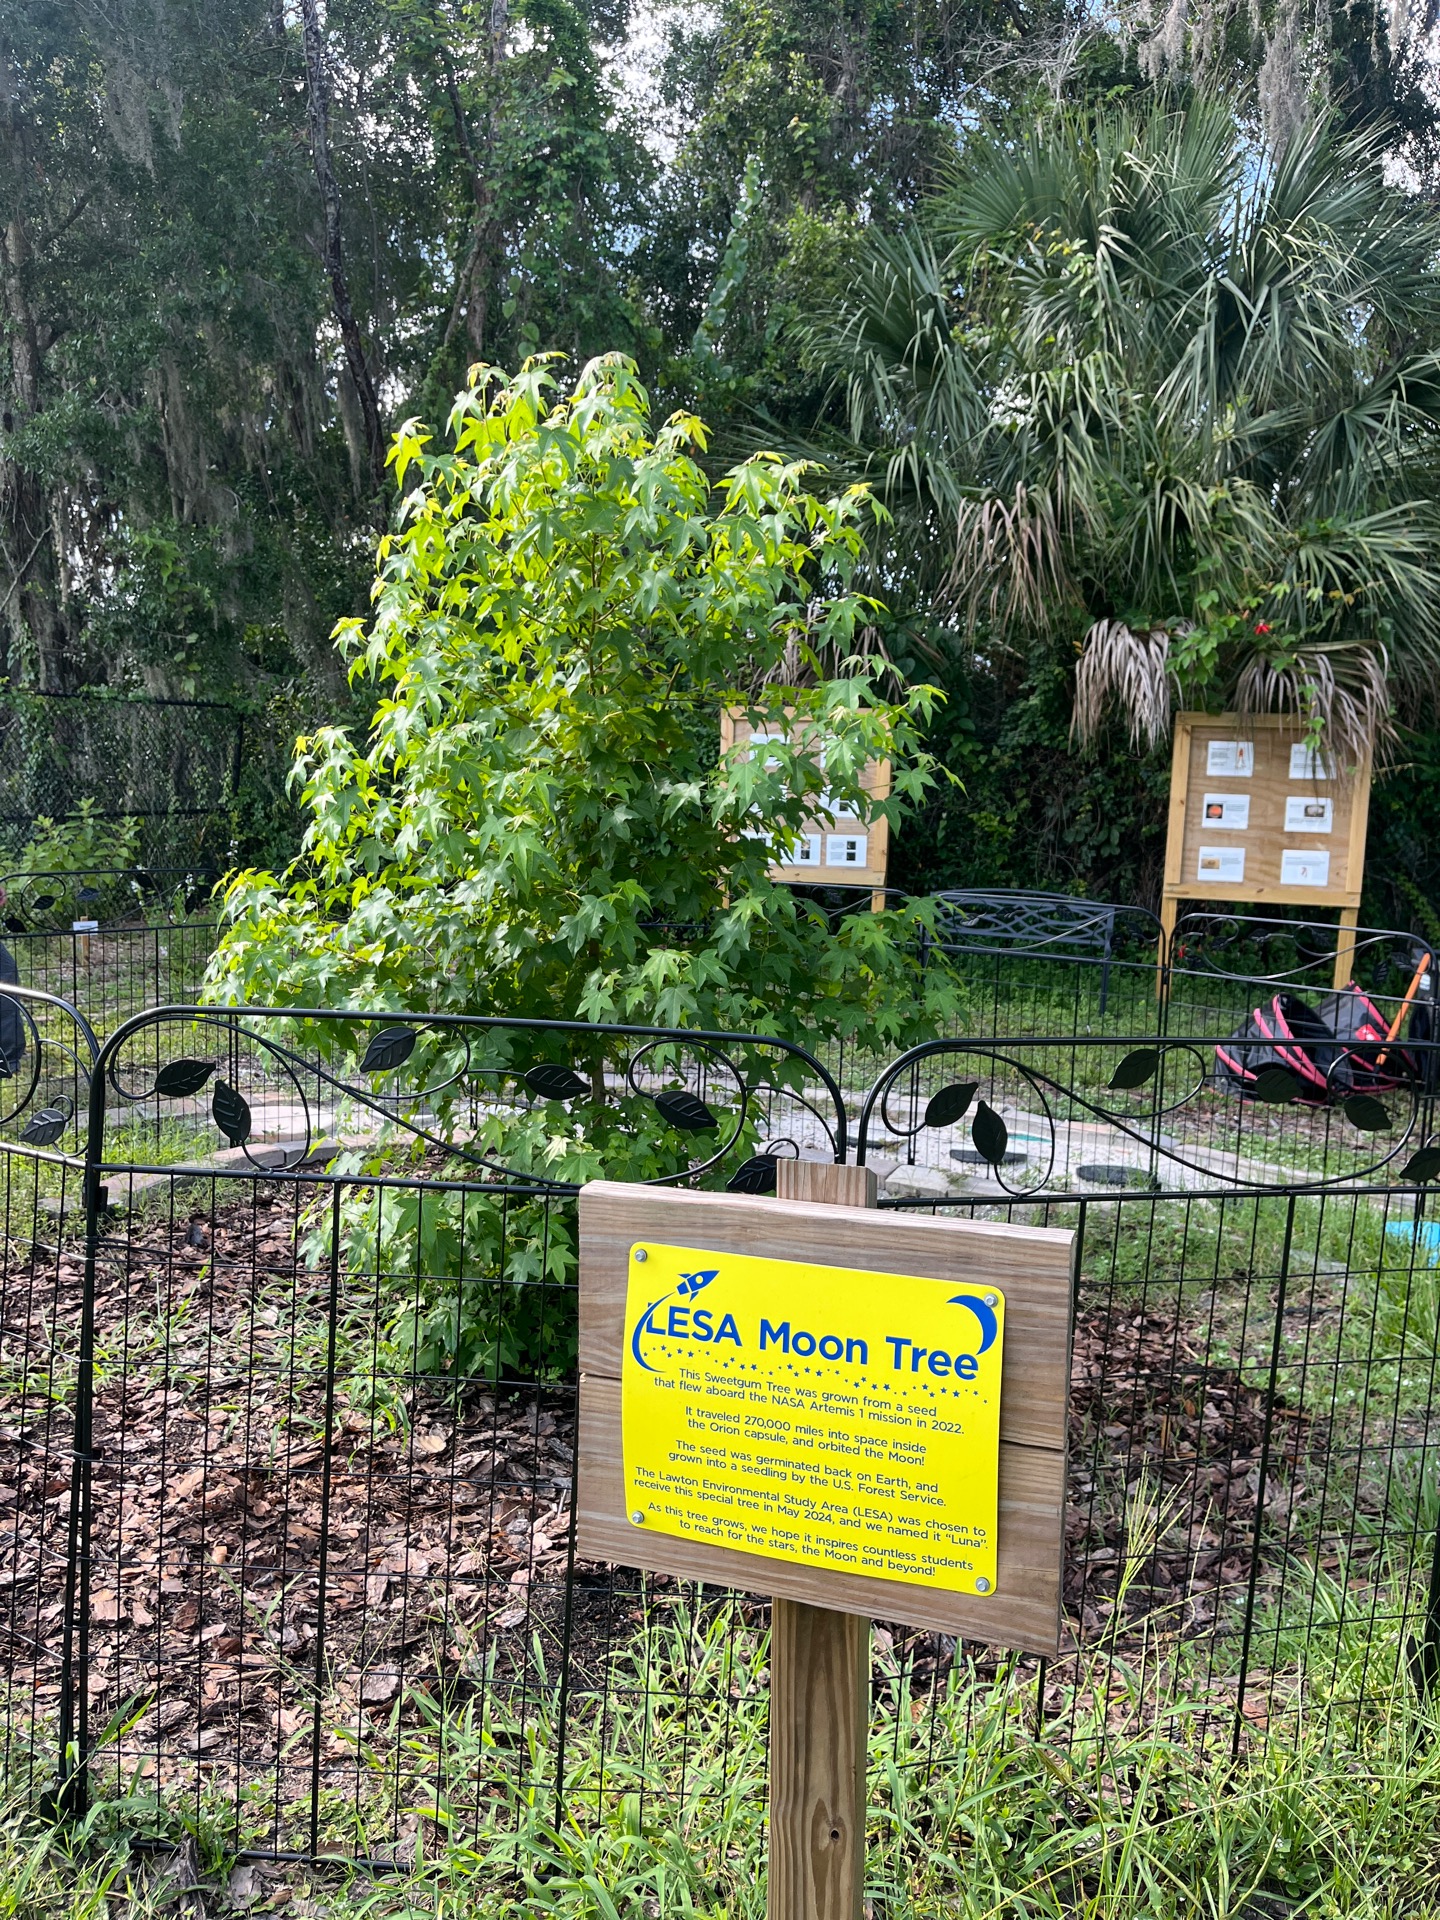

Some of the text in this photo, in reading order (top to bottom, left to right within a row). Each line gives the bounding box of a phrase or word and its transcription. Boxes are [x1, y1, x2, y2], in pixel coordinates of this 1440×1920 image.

[646, 1302, 979, 1381] LESA Moon Tree
[653, 1376, 965, 1435] that flew aboard the NASA Artemis 1 mission in 2022.
[678, 1367, 938, 1418] This Sweetgum Tree was grown from a seed
[685, 1405, 927, 1455] It traveled 270,000 miles into space inside
[687, 1418, 925, 1467] the Orion capsule, and orbited the Moon!
[668, 1451, 947, 1507] grown into a seedling by the U.S. Forest Service.
[675, 1439, 939, 1494] The seed was germinated back on Earth, and
[633, 1478, 672, 1493] receive
[673, 1485, 694, 1498] this
[696, 1490, 734, 1505] special
[736, 1496, 760, 1511] tree
[763, 1501, 774, 1513] in
[777, 1504, 801, 1519] May
[803, 1509, 836, 1526] 2024,
[838, 1517, 862, 1529] and
[865, 1521, 883, 1533] we
[886, 1525, 929, 1540] named
[932, 1530, 942, 1542] it
[635, 1465, 987, 1537] The Lawton Environmental Study Area (LESA) was chosen to
[647, 1501, 973, 1571] As this tree grows, we hope it inspires countless students
[679, 1519, 935, 1576] to reach for the stars, the Moon and beyond!
